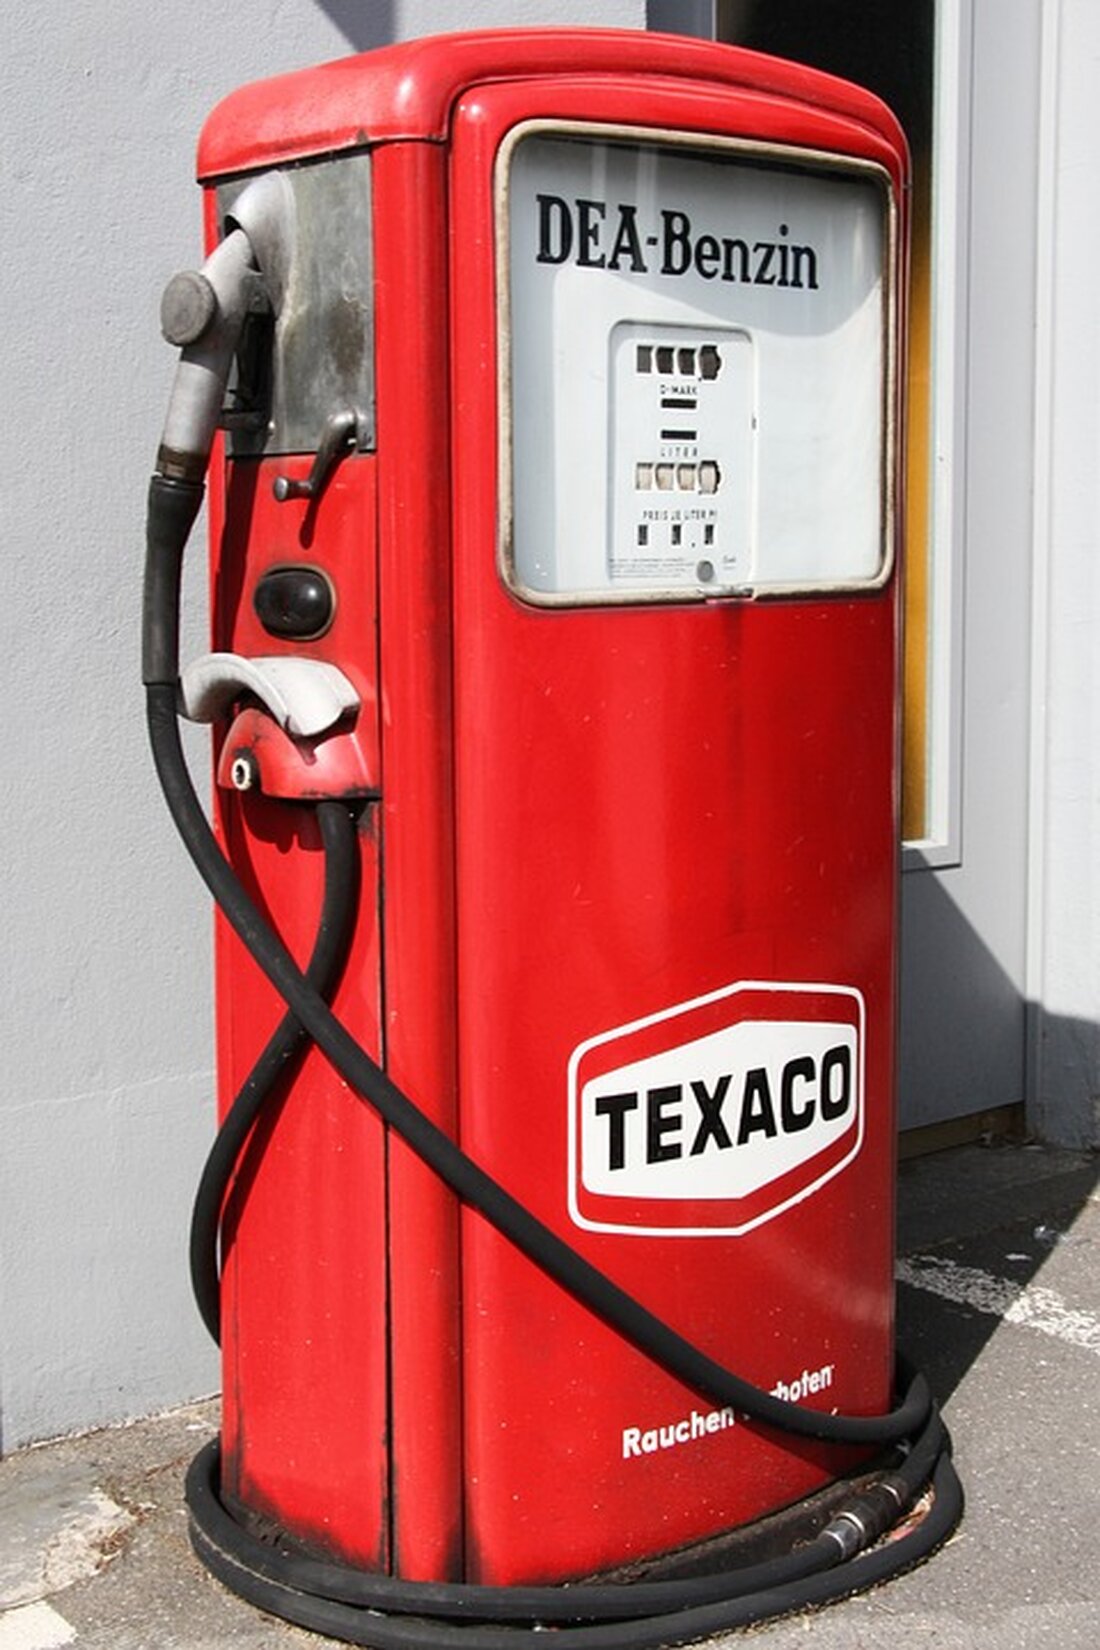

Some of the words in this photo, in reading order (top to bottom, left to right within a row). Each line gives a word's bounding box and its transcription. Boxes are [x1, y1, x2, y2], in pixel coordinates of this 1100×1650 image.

[536, 194, 818, 289] DEA-Benzin
[660, 384, 698, 396] D-MARK
[660, 446, 698, 457] LITER
[643, 510, 668, 521] PREIS
[670, 510, 681, 521] JE
[683, 509, 707, 521] LITER
[595, 1045, 851, 1171] TEXACO
[622, 1407, 735, 1459] Rauchen
